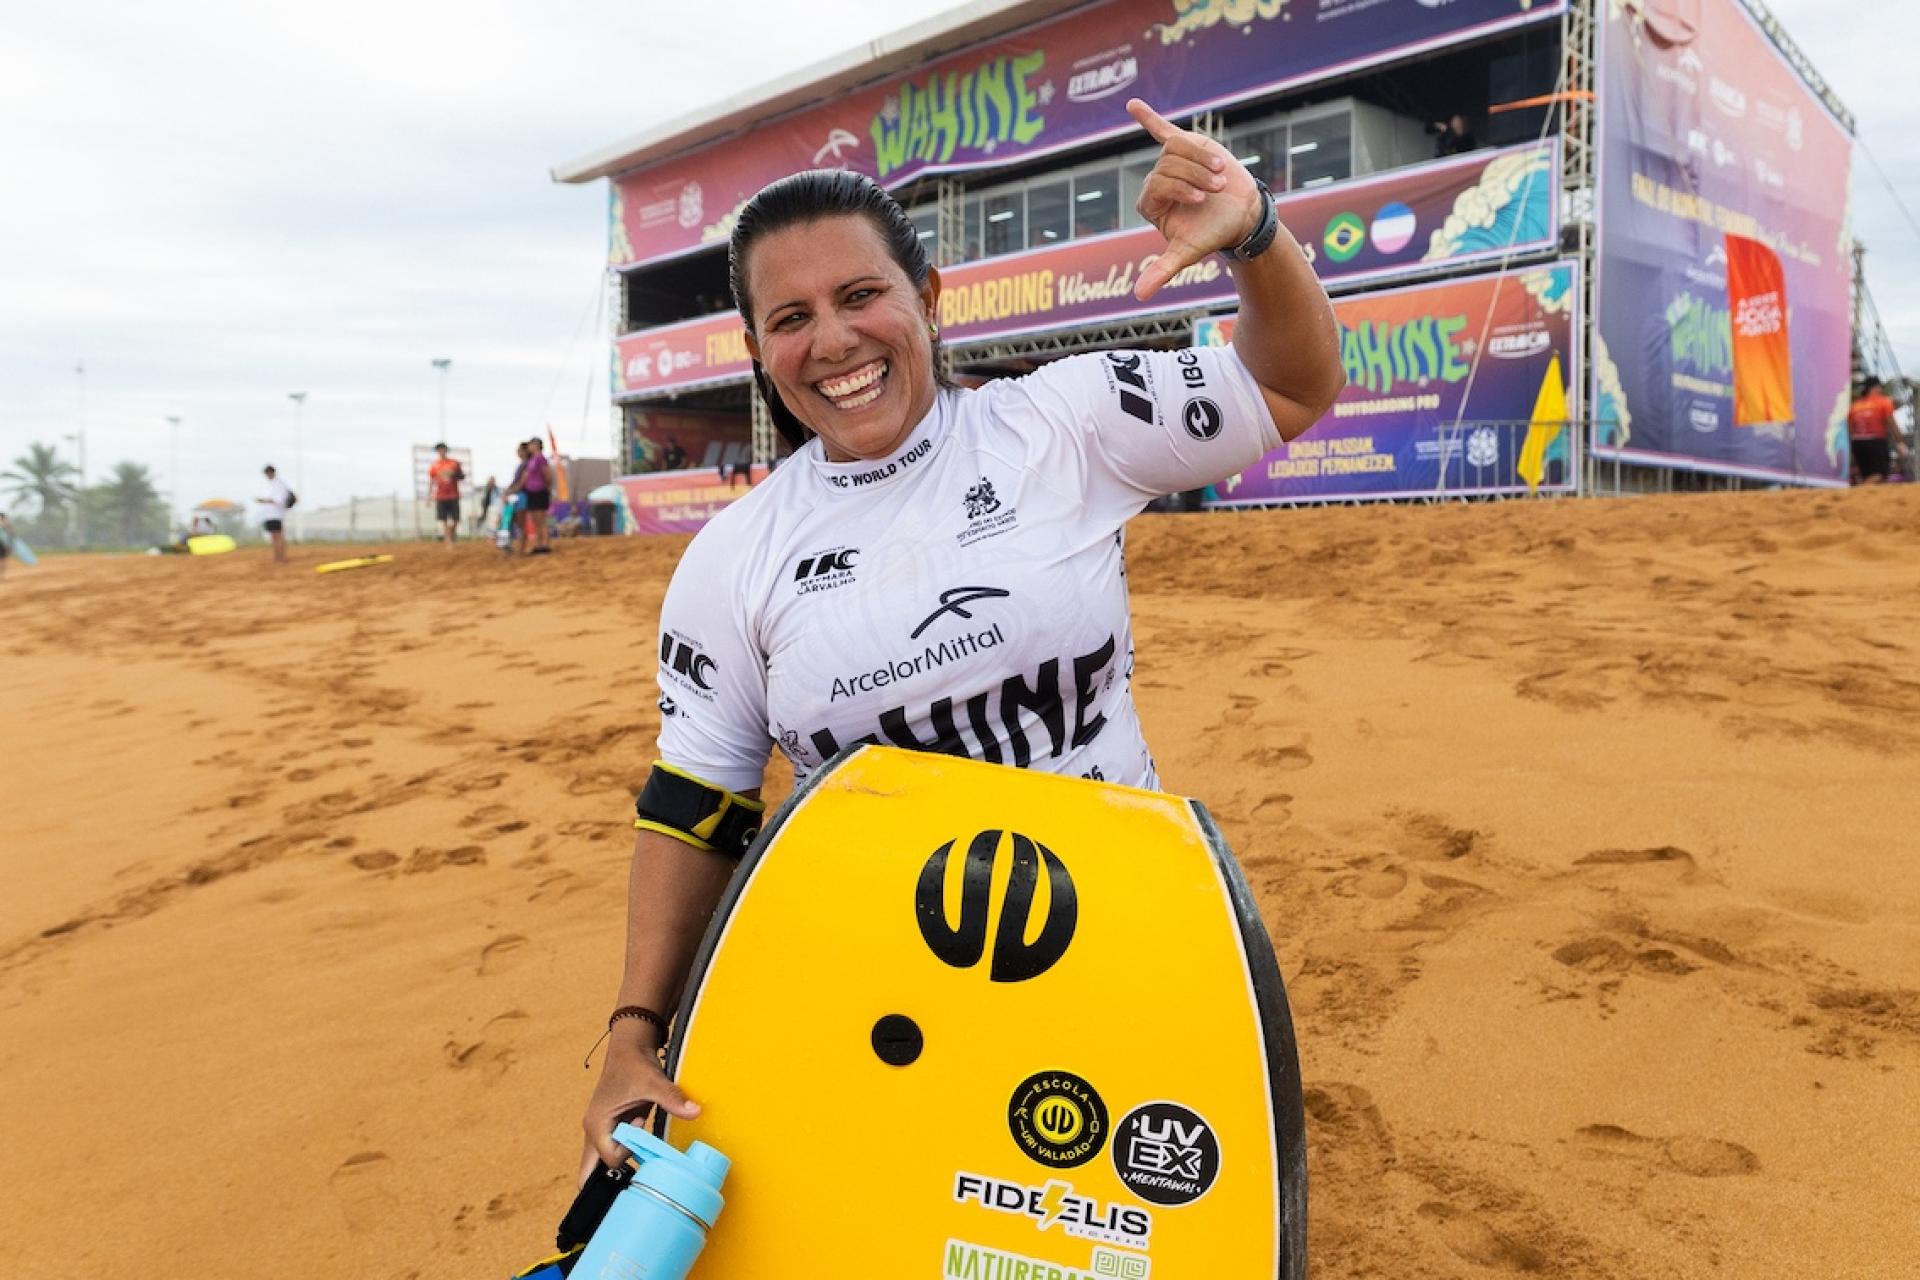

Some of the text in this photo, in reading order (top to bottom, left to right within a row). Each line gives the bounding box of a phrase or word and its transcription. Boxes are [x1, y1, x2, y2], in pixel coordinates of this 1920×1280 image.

[869, 49, 1045, 177] WAHINE
[941, 269, 1052, 327] BOARDING
[1058, 261, 1133, 306] World
[1340, 314, 1469, 394] AHINE
[851, 463, 897, 487] WORLD
[898, 438, 932, 467] TOUR
[829, 623, 1005, 702] ArcelorMittal
[1032, 1078, 1090, 1102] ESCOLA
[1021, 1129, 1037, 1150] URI
